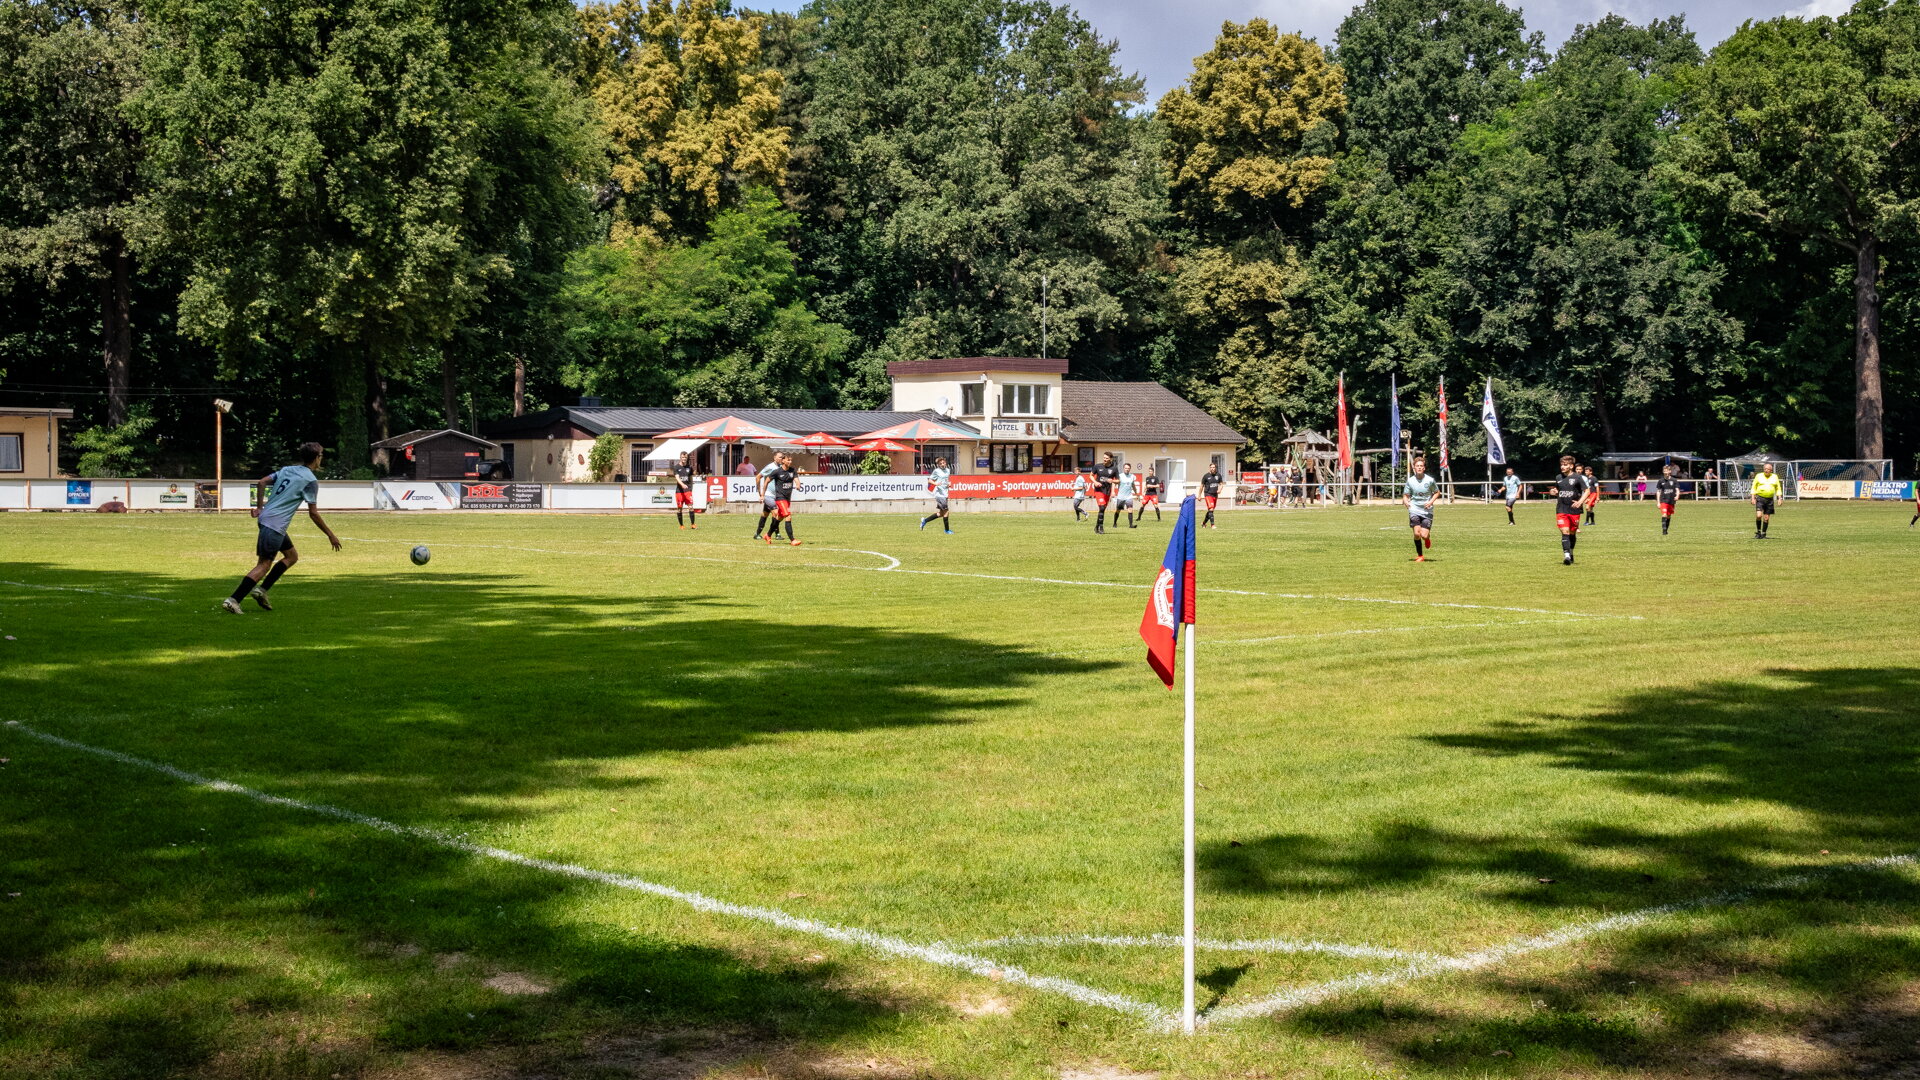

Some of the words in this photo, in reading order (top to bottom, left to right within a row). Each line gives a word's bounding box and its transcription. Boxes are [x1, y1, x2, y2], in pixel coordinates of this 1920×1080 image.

[275, 479, 290, 495] 6
[831, 482, 849, 492] und
[851, 482, 923, 492] Freizeitzentrum
[1002, 480, 1042, 493] Sportowy
[1800, 482, 1829, 492] Richter
